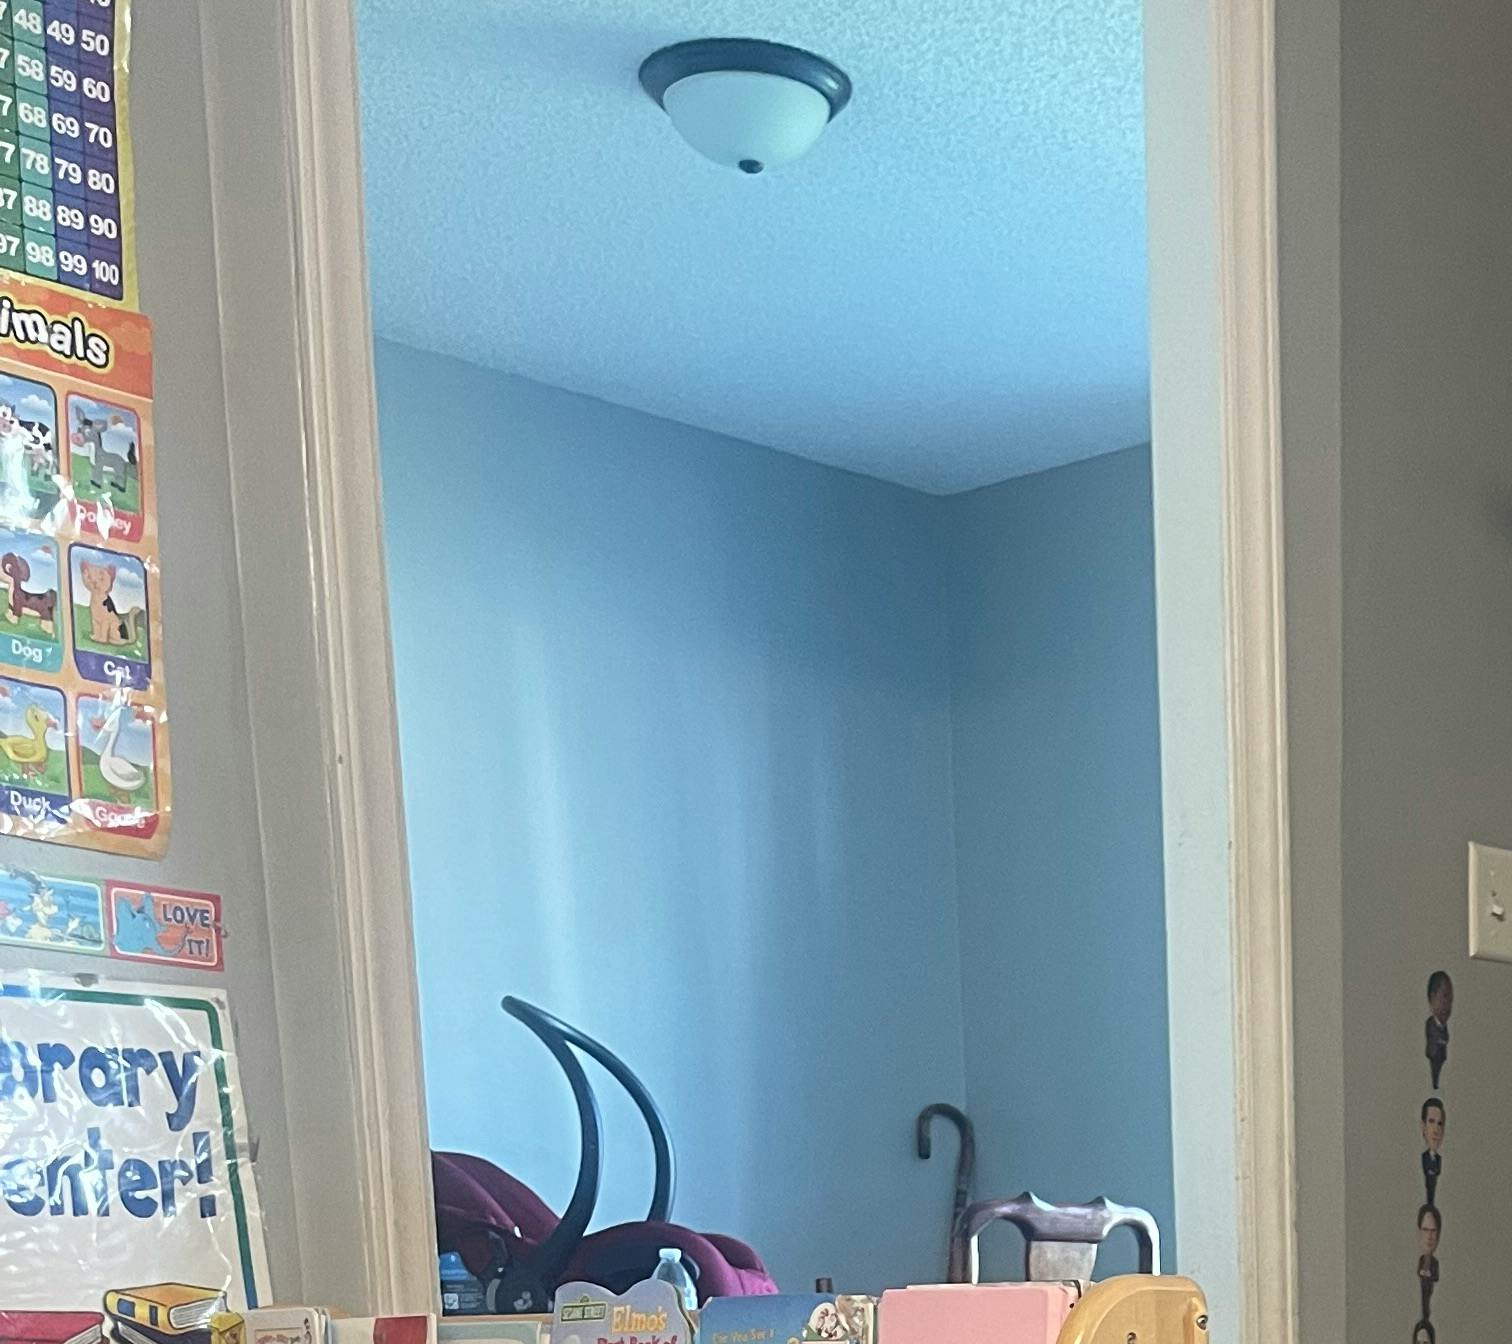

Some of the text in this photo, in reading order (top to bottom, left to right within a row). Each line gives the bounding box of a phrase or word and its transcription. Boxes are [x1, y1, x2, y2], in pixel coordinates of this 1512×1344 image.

[14, 9, 42, 34] 48
[47, 22, 75, 46] 49
[80, 30, 110, 57] 50
[0, 48, 110, 103] 7 58 59 60
[0, 95, 112, 148] 7 68 69 70
[0, 141, 115, 195] 7 78 79 80
[23, 195, 52, 221] 88
[57, 205, 85, 230] 89
[89, 214, 117, 239] 90
[26, 241, 55, 267] 98
[59, 252, 87, 276] 99
[92, 260, 120, 286] 100
[0, 299, 109, 368] imals
[76, 503, 131, 536] Doey
[12, 639, 42, 662] Dog
[10, 790, 51, 811] Duck
[162, 904, 210, 927] LOVE
[187, 938, 210, 957] IT!
[0, 1040, 201, 1131] brary
[0, 1127, 217, 1219] enter!
[611, 1303, 668, 1334] Elmo's
